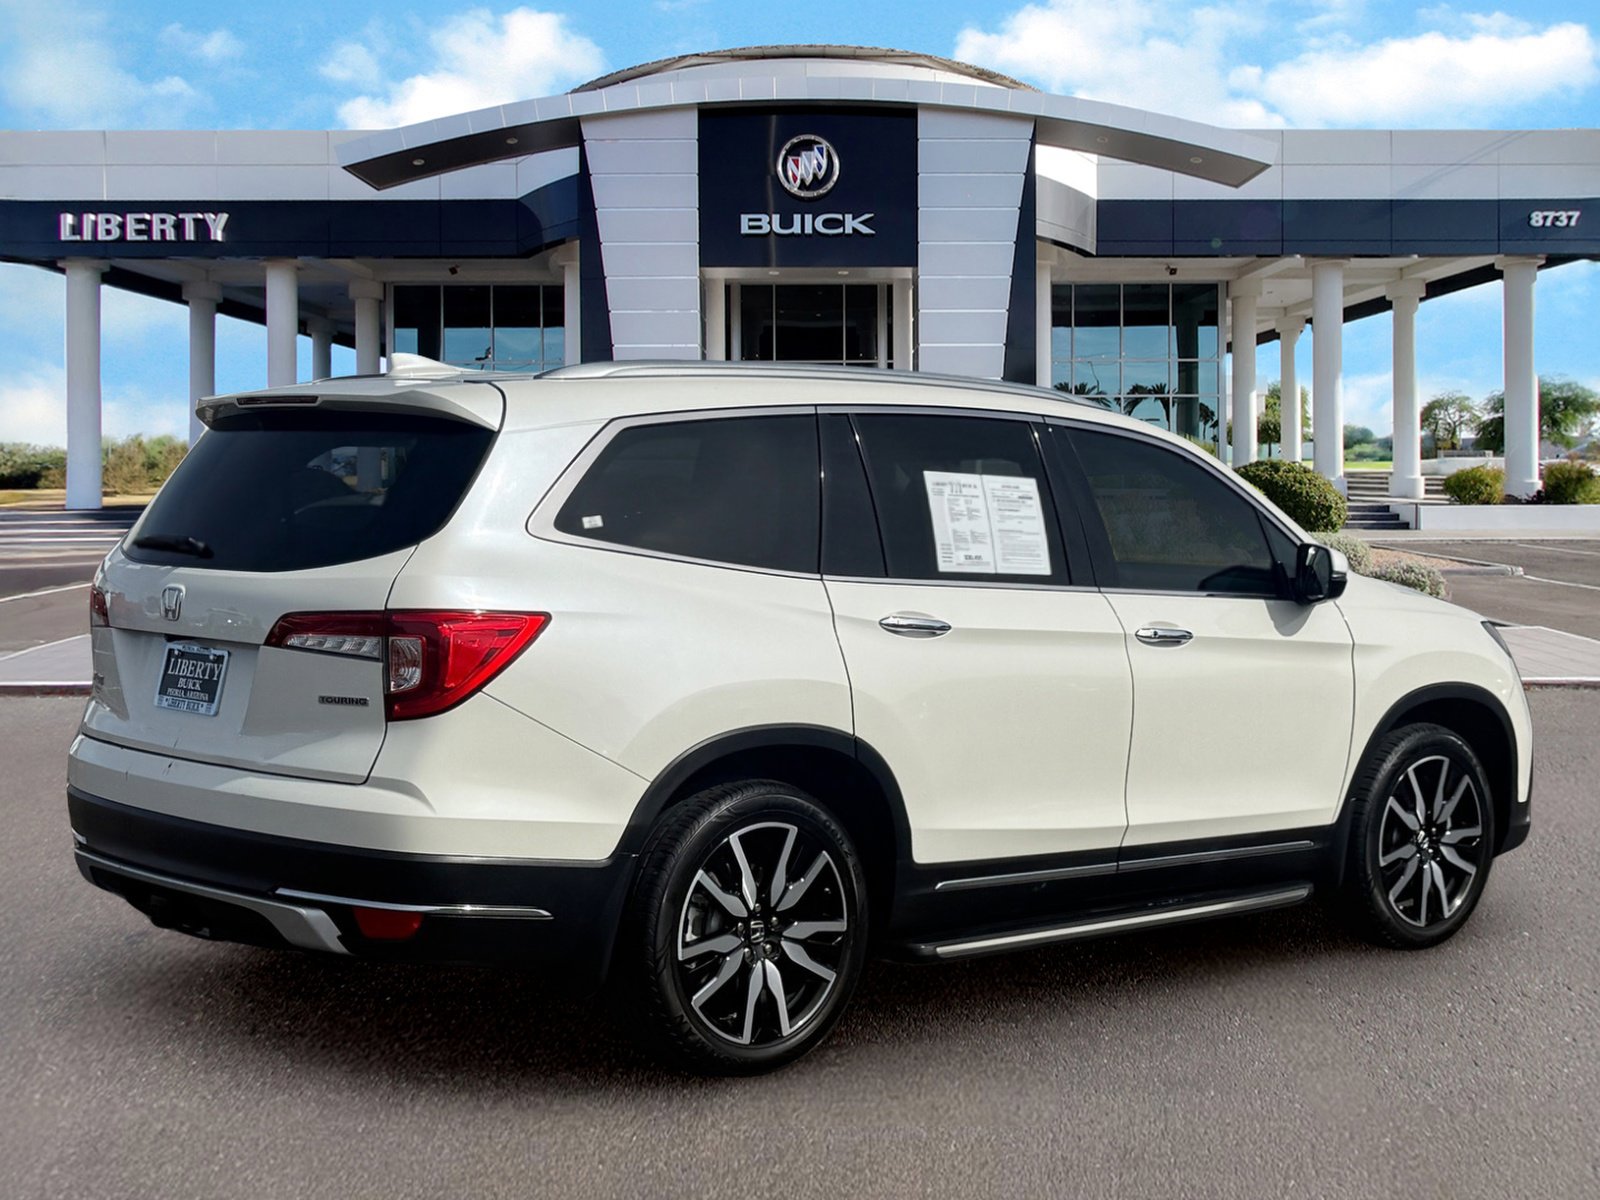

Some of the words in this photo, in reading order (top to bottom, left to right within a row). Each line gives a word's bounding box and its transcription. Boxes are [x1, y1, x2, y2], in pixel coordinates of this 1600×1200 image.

[59, 212, 229, 242] LIBERTY
[740, 212, 876, 235] BUICK
[1529, 210, 1581, 228] 8737
[168, 658, 222, 680] LIBERTY
[177, 678, 202, 690] BUICK
[318, 695, 369, 707] TOURING
